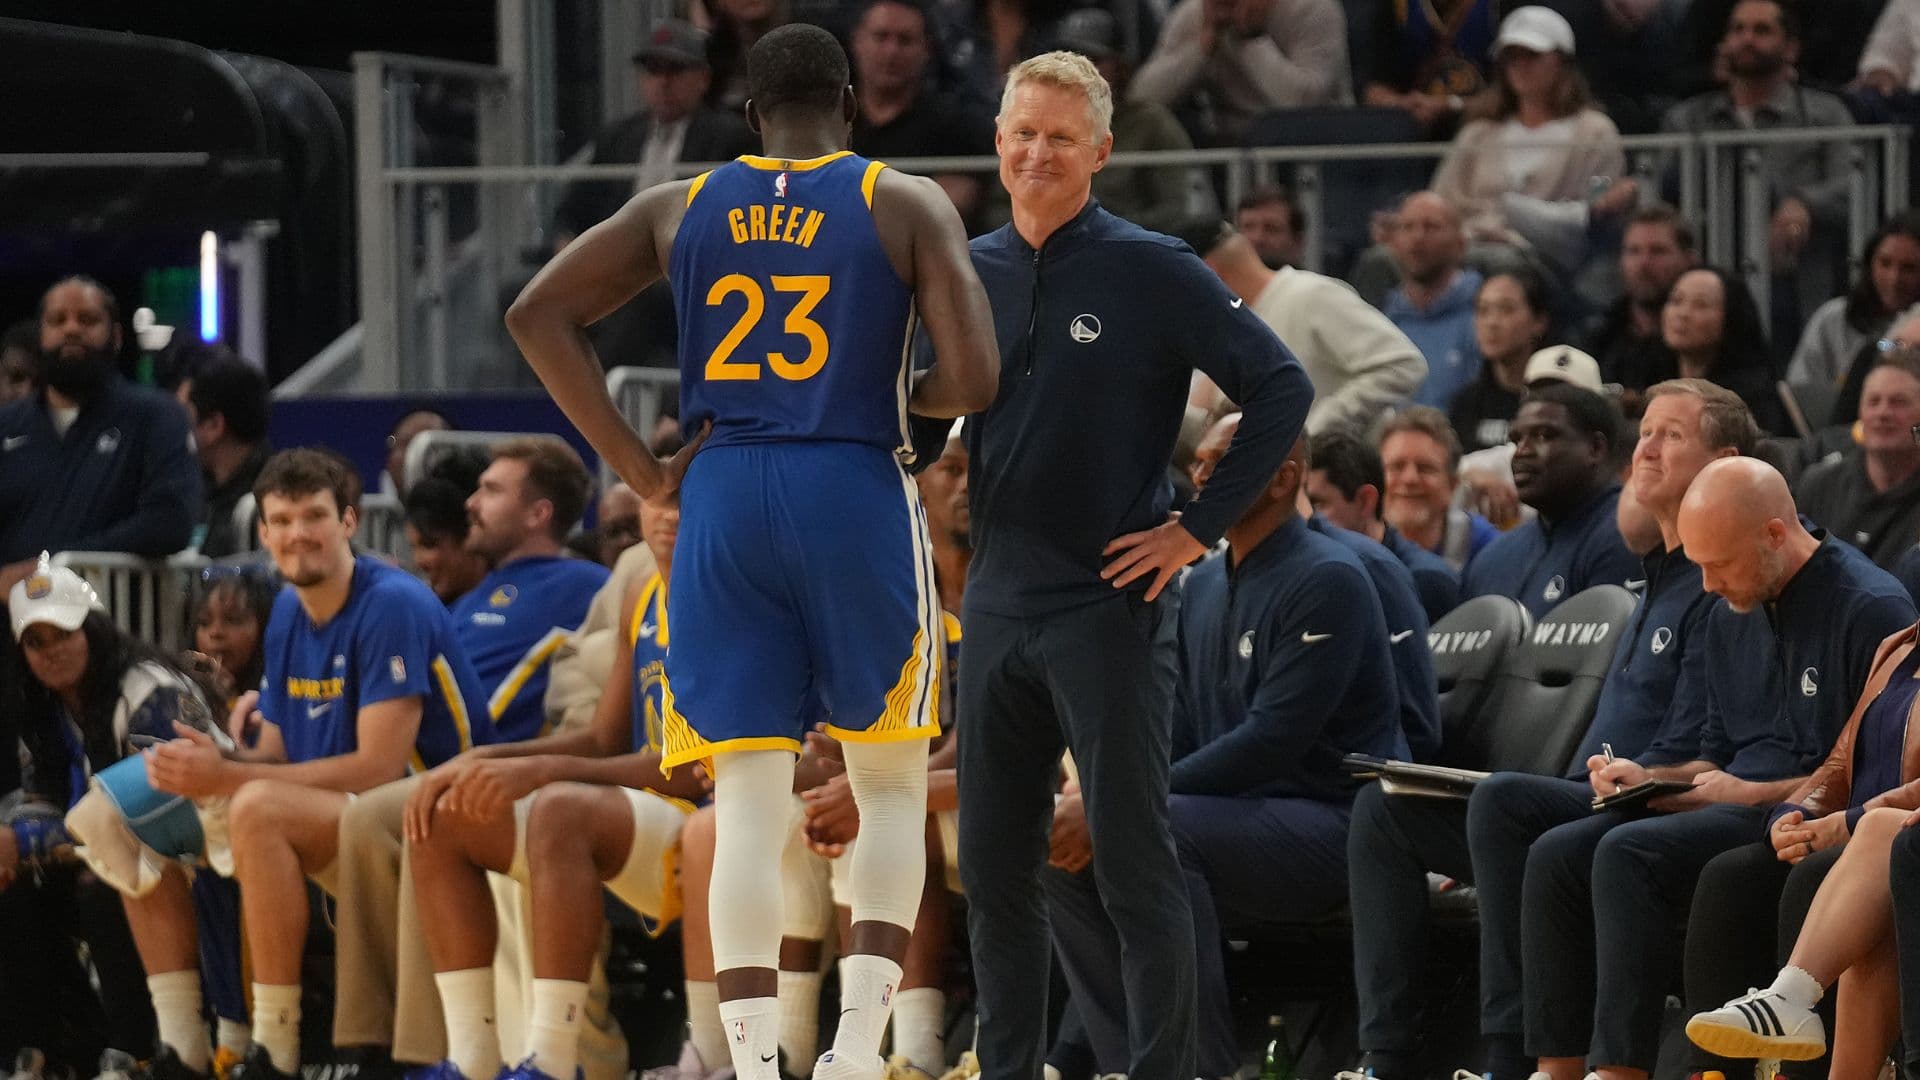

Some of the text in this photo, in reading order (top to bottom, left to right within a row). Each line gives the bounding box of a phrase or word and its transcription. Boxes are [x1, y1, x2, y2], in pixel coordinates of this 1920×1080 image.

[727, 204, 825, 248] GREEN
[704, 272, 831, 381] 23
[1533, 622, 1610, 645] WAYMO
